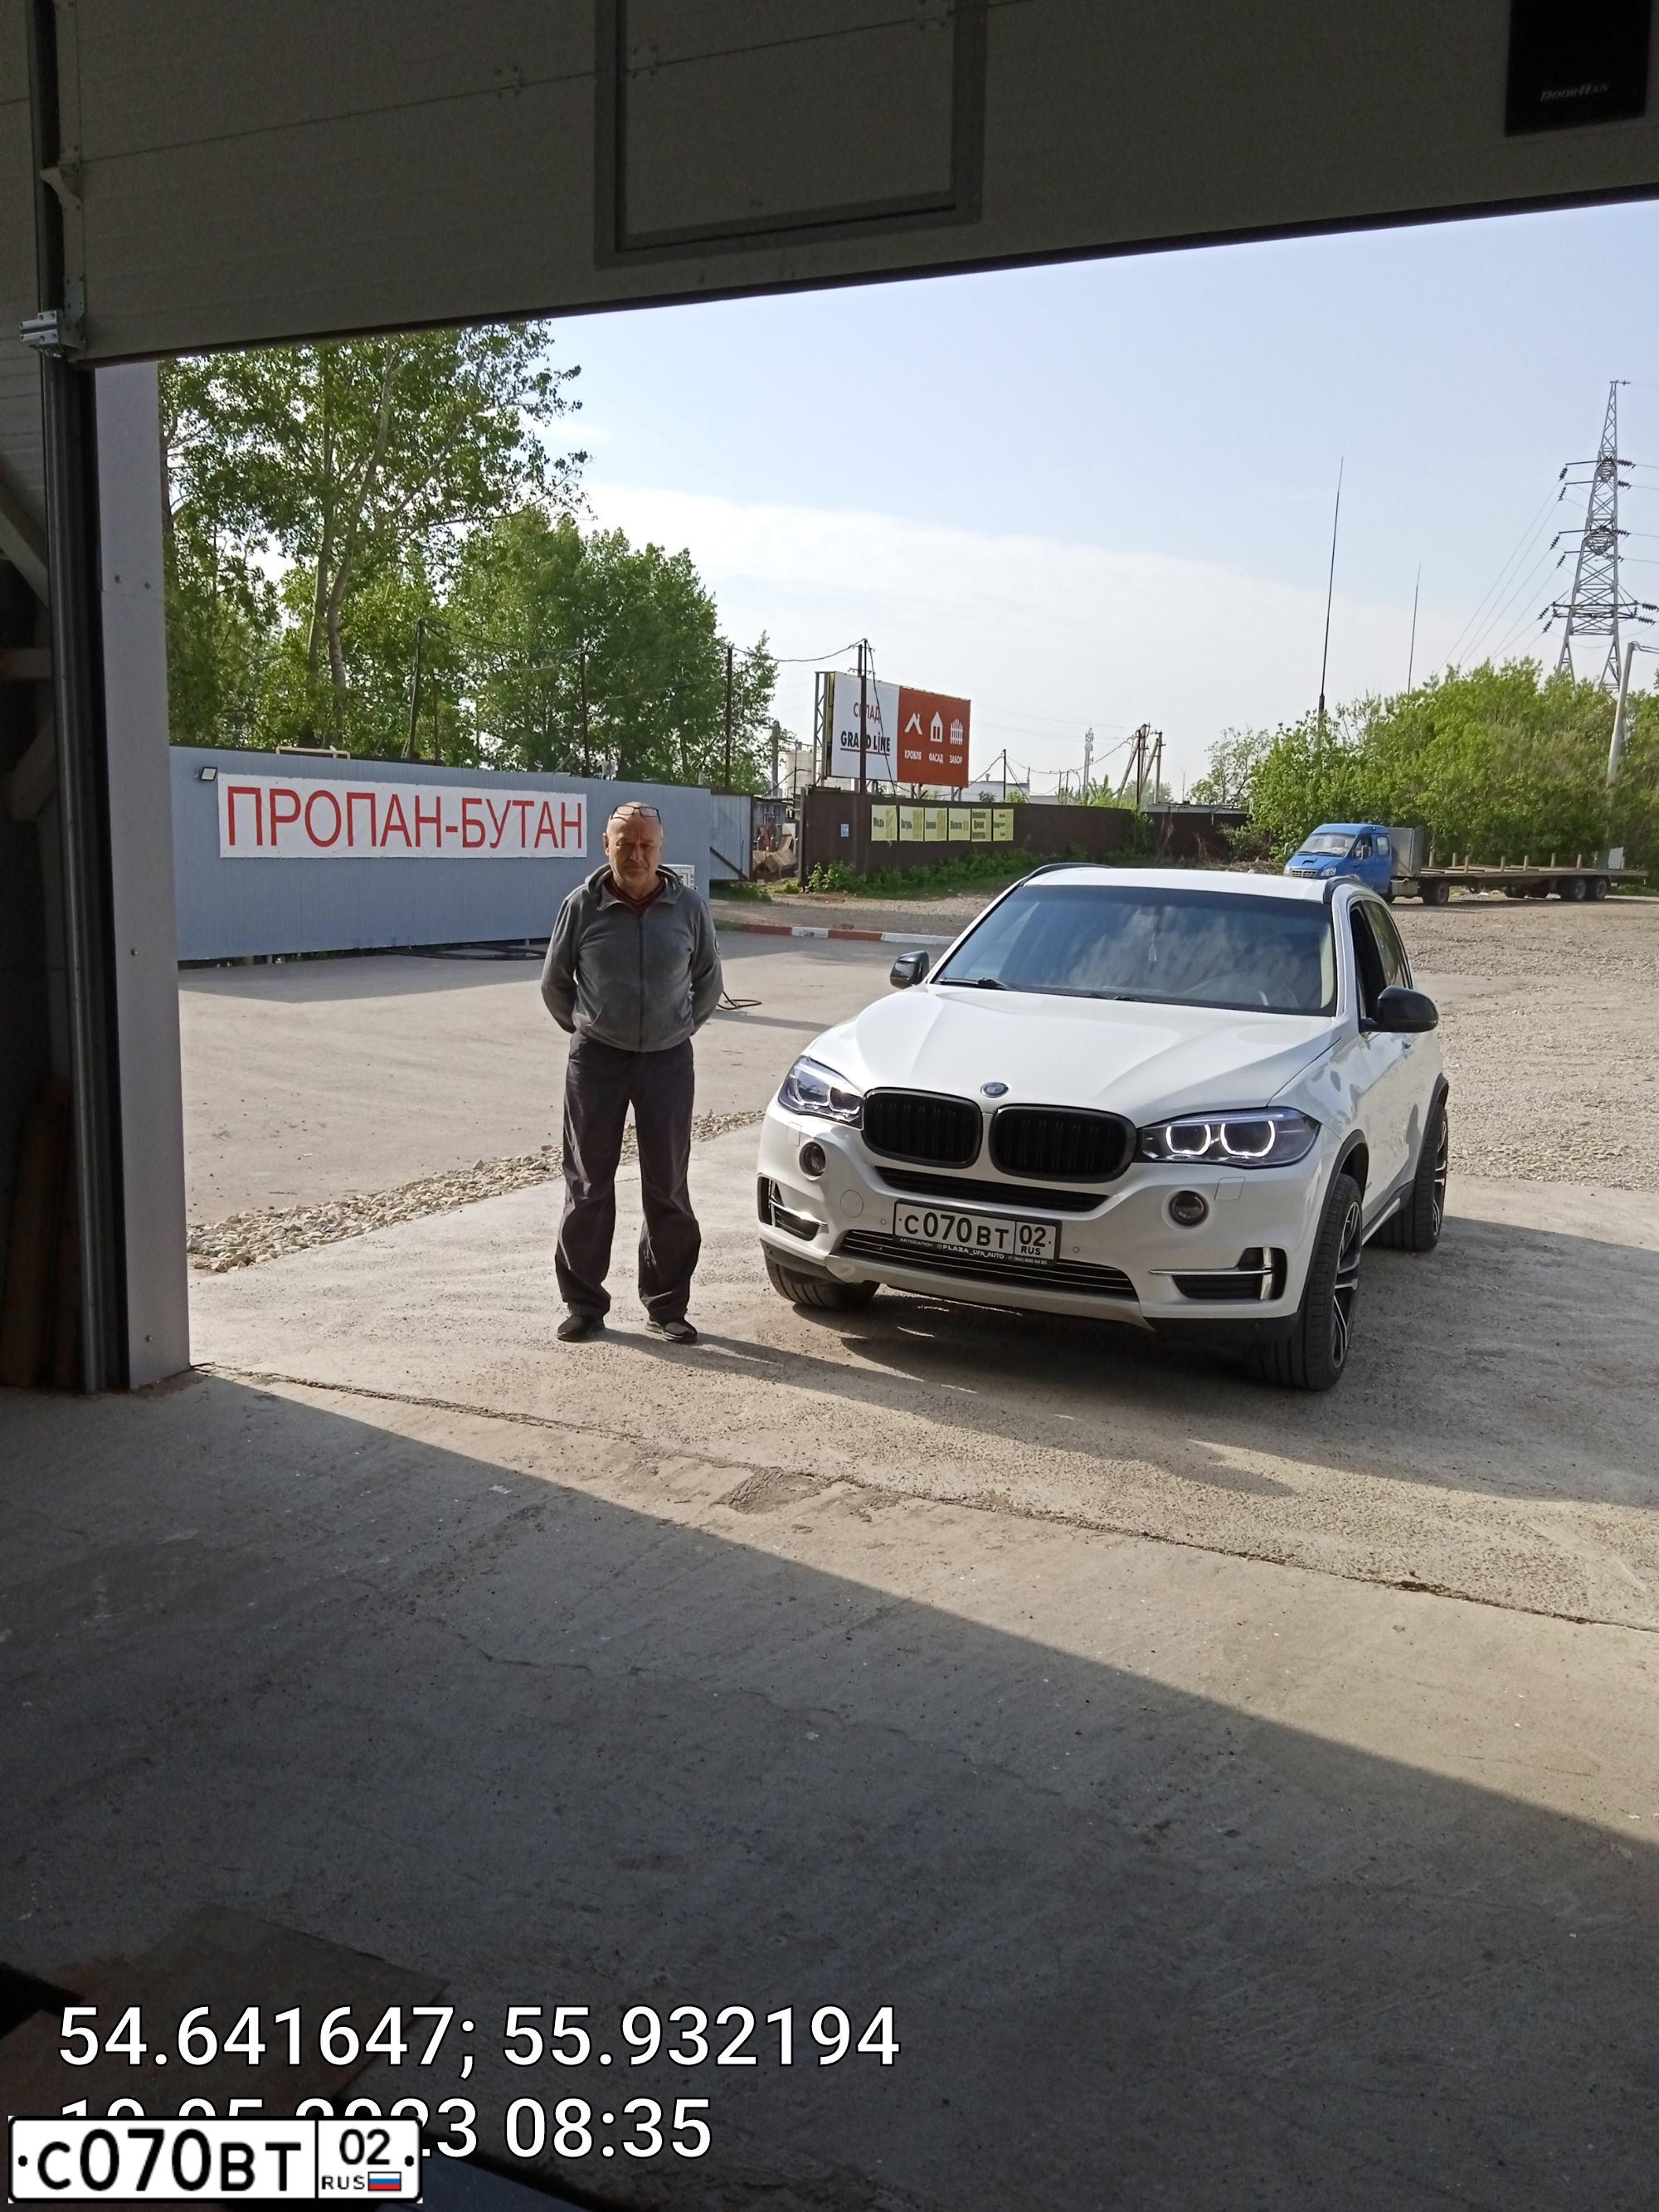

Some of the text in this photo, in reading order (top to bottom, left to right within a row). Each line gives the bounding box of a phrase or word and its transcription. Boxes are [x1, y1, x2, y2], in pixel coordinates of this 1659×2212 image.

[854, 702, 881, 724] СЛАД
[840, 730, 871, 749] GRAD
[928, 753, 944, 764] ФАСАД
[949, 755, 962, 764] ЗАБОР
[226, 786, 582, 849] ПРОПАН-БУТАН
[1019, 1225, 1047, 1247] 02
[1020, 1246, 1042, 1256] RUS
